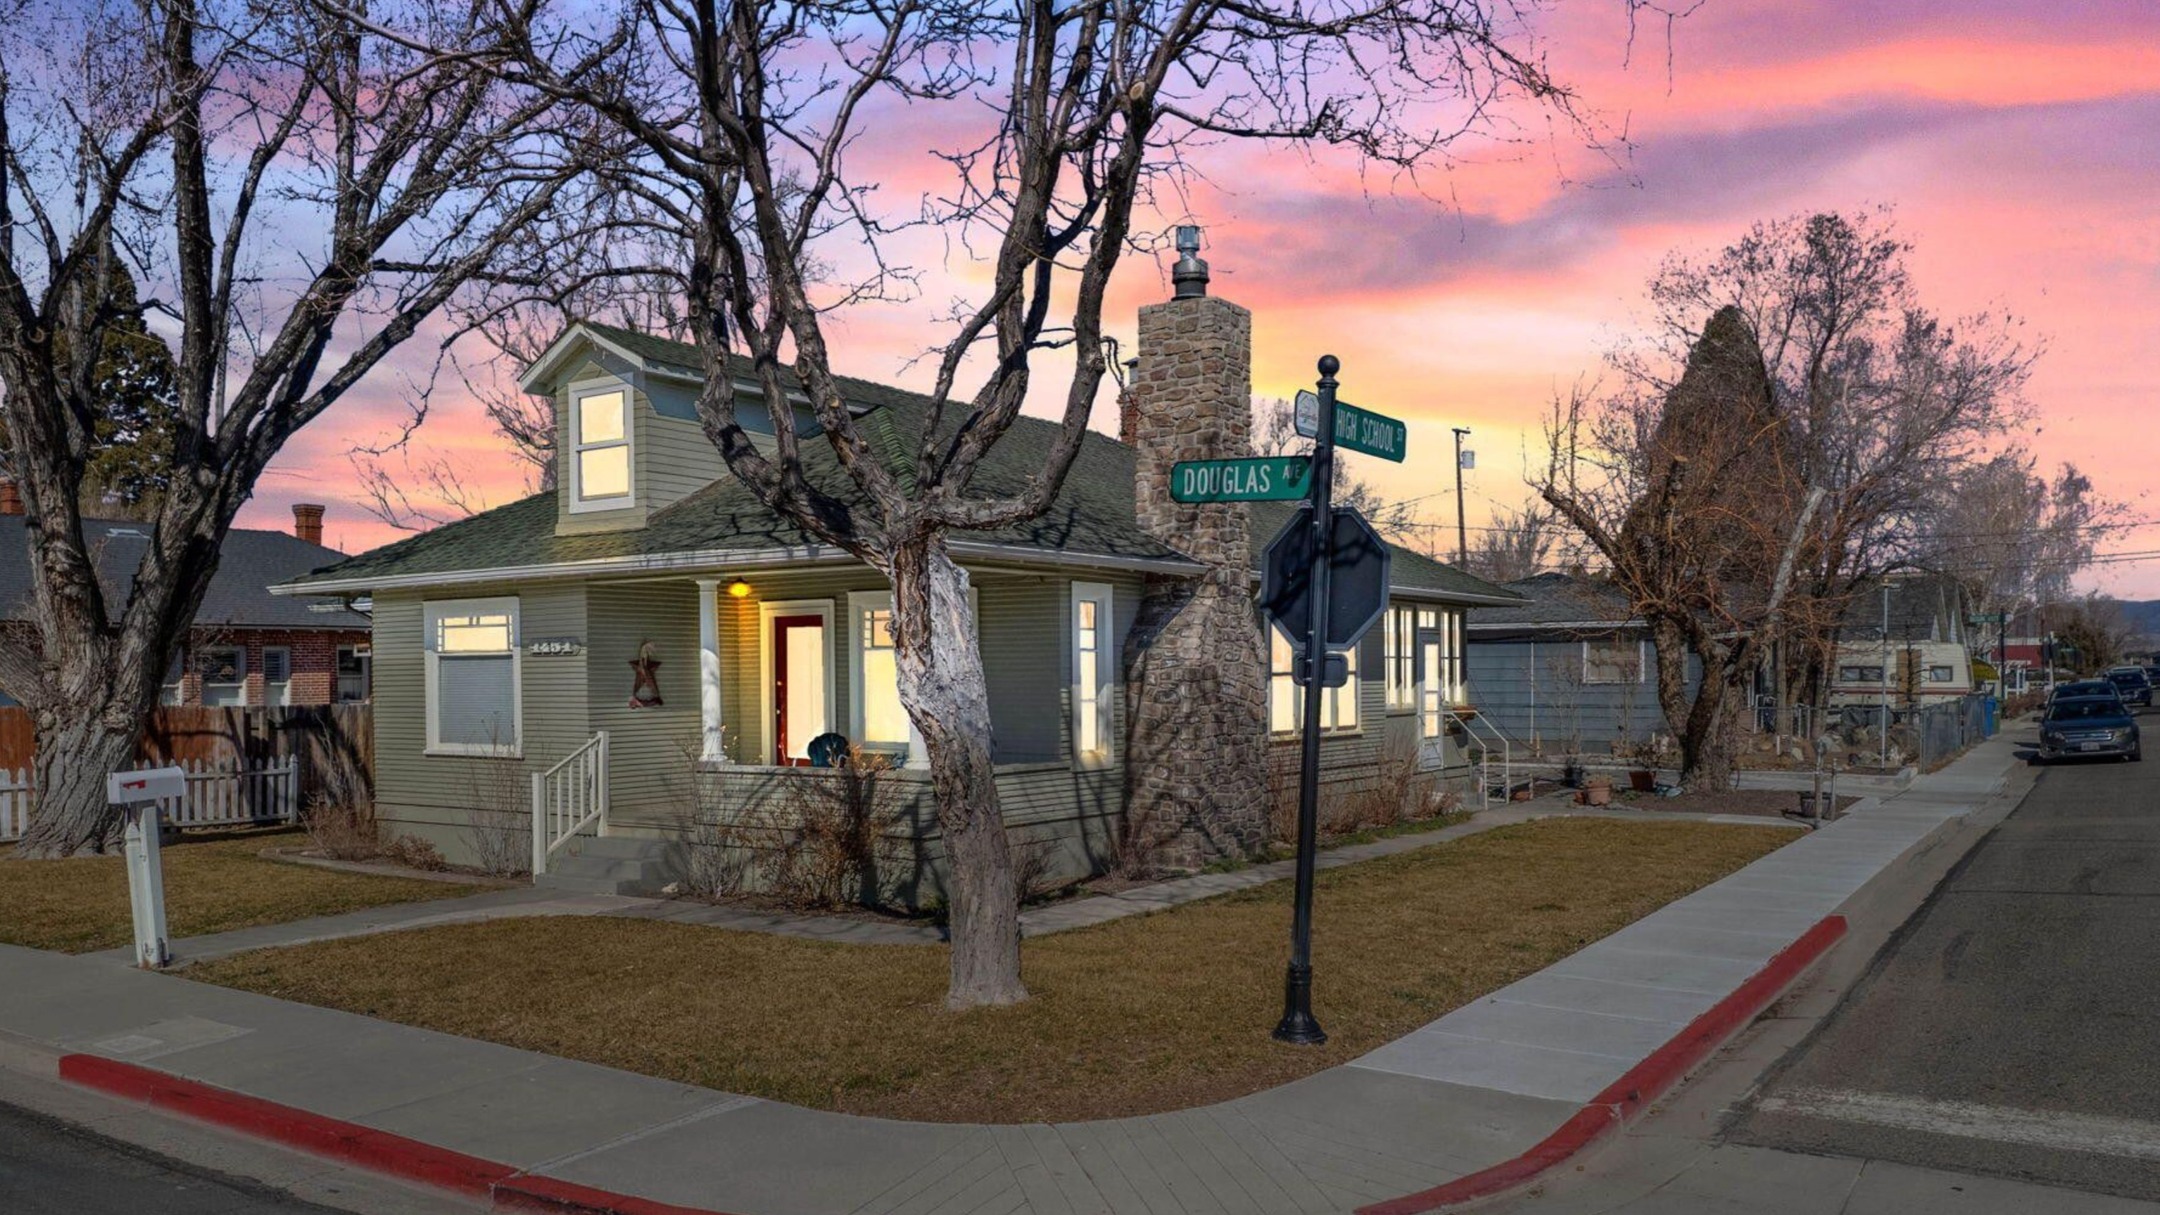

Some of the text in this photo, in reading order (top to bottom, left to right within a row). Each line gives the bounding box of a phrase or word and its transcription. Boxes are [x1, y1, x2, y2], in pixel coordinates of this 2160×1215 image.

[1336, 408, 1404, 453] HIGH SCHOOL ST
[1184, 465, 1300, 495] DOUGLAS AVE
